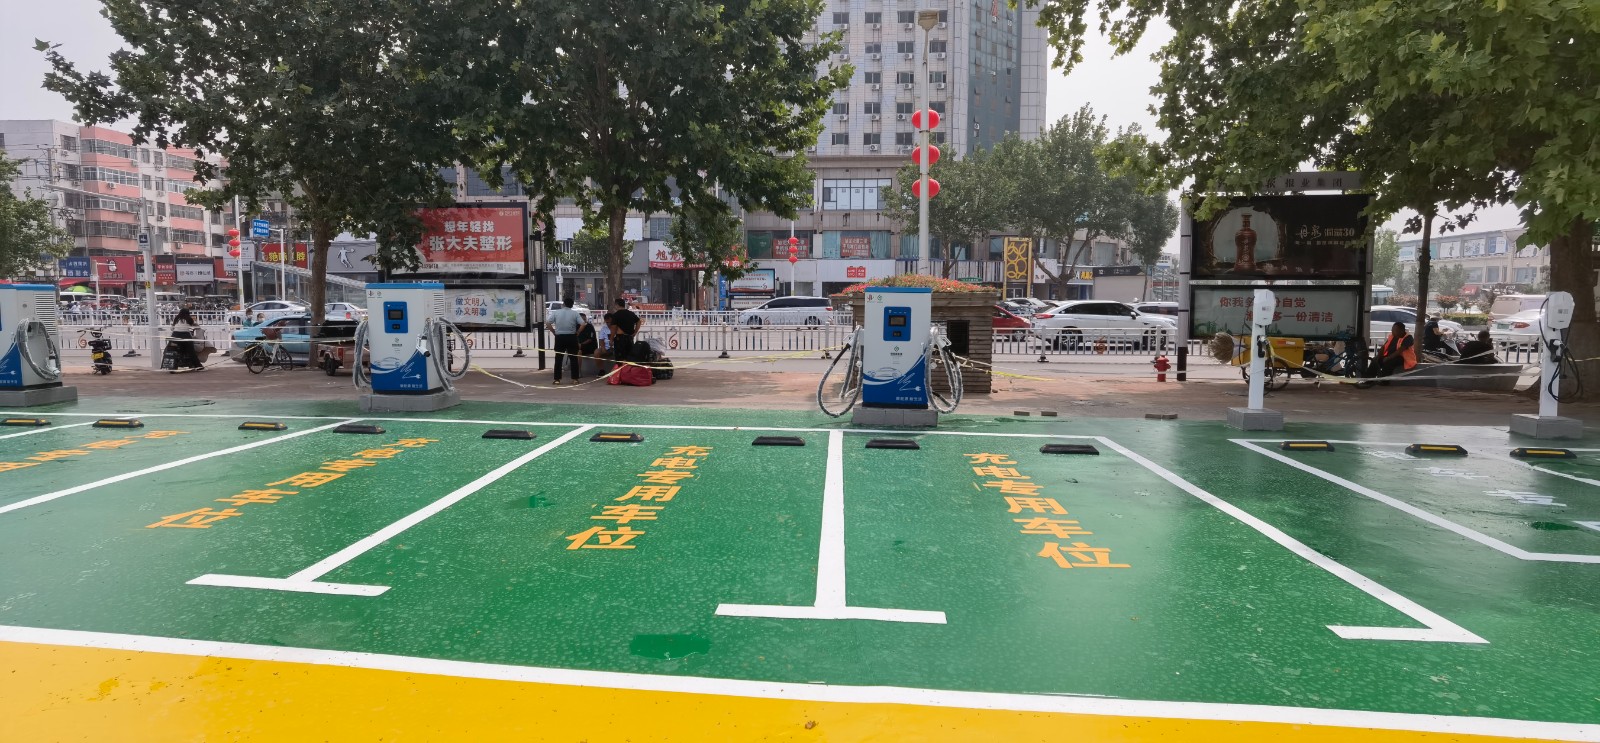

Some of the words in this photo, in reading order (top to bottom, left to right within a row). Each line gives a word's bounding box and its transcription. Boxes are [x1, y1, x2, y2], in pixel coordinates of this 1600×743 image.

[444, 221, 494, 233] 想年轻找
[429, 236, 512, 251] 张大夫整形
[456, 297, 487, 306] 做文明人
[1219, 297, 1306, 308] 你我多自觉
[456, 308, 487, 316] 办文明事
[1246, 311, 1333, 323] 多一份清洁
[145, 438, 439, 528] 充电专用车位
[565, 445, 714, 550] 充电专用车位
[963, 453, 1132, 568] 充电专用车位
